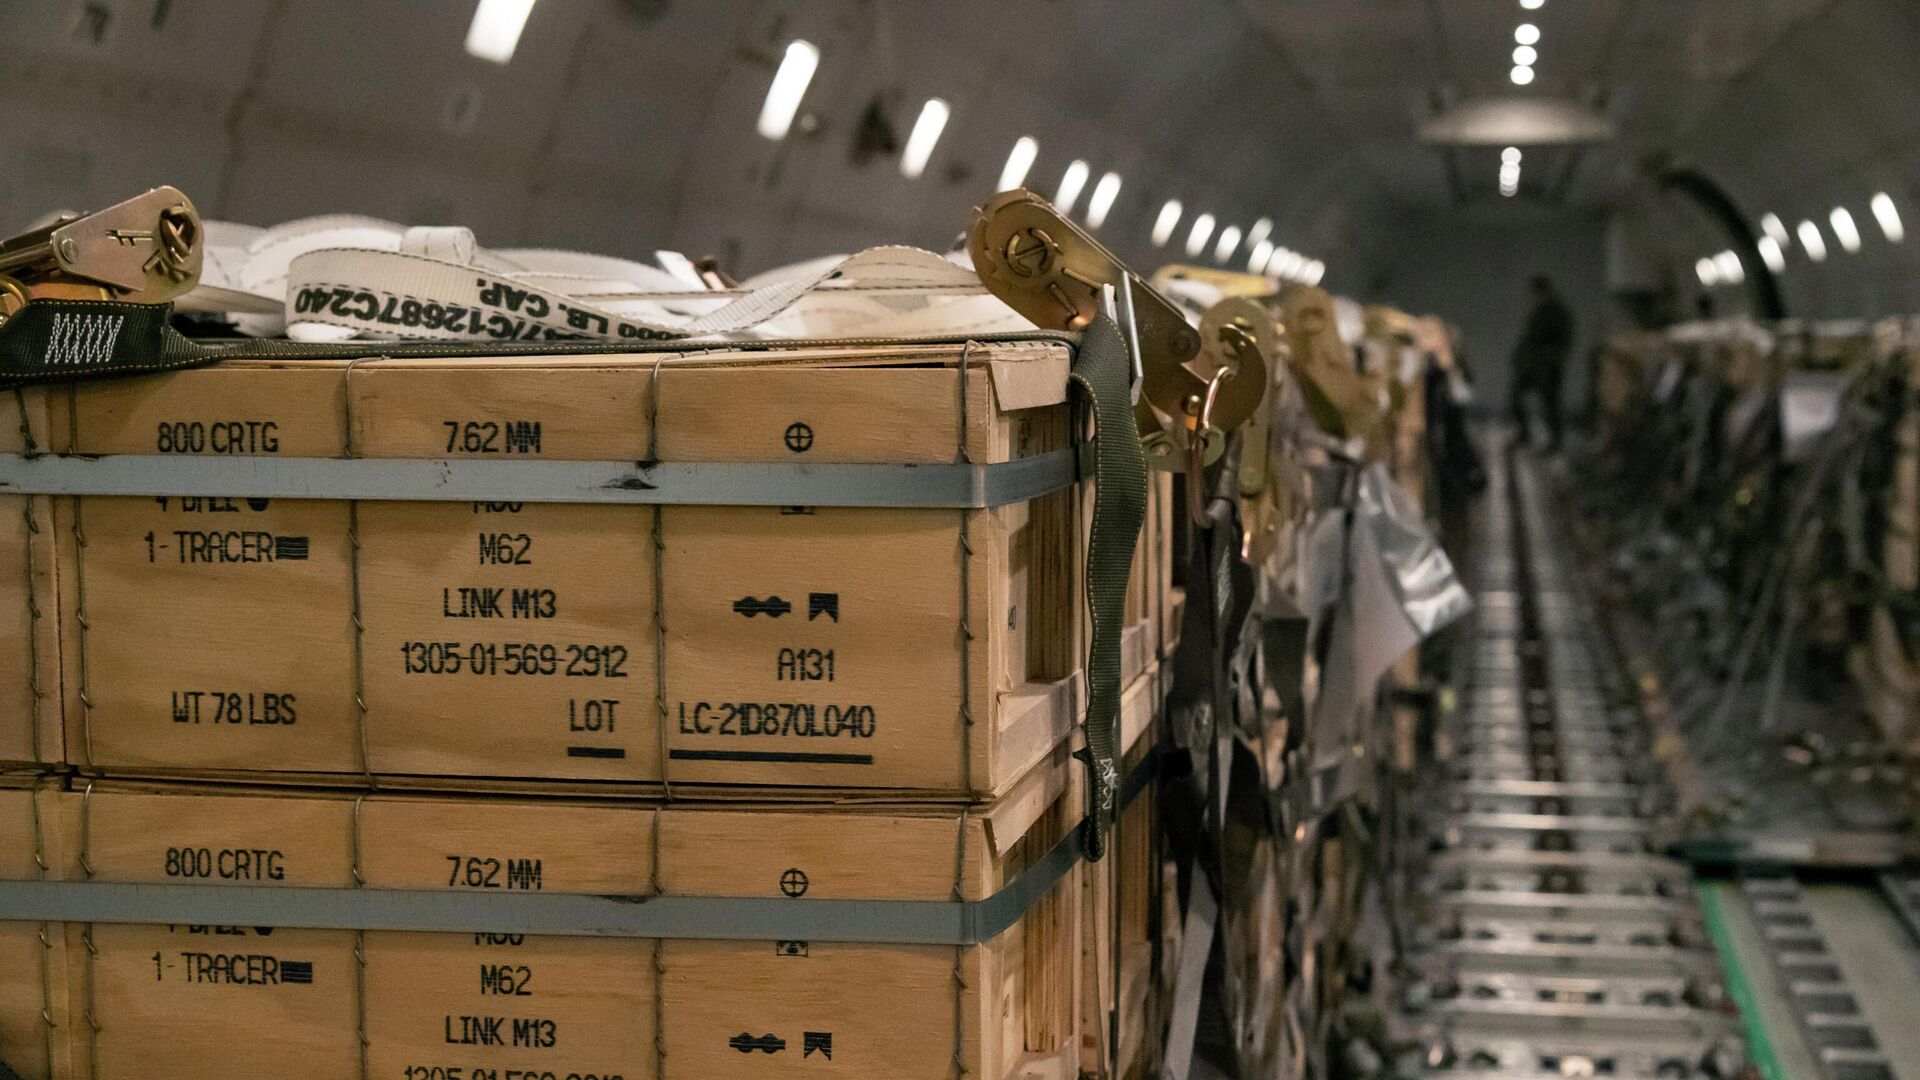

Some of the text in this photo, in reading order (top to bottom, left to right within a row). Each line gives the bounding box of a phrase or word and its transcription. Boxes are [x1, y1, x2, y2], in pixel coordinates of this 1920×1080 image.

[475, 278, 551, 319] CAP.
[557, 303, 610, 335] LB.
[157, 421, 279, 455] 800 CRTG
[443, 420, 542, 454] 7.62 MM
[172, 530, 274, 564] TRACER
[479, 532, 532, 566] M62
[443, 587, 557, 620] LINK M13
[400, 643, 628, 678] 1305-01-569-2912
[777, 647, 835, 682] A131
[172, 691, 297, 726] WT 78 LBS
[569, 699, 620, 733] LOT
[165, 847, 285, 881] 800 CRTG
[446, 855, 542, 890] 7.62 MM
[180, 952, 279, 985] TRACER
[480, 964, 532, 996] M62
[445, 1015, 557, 1049] LINK M13
